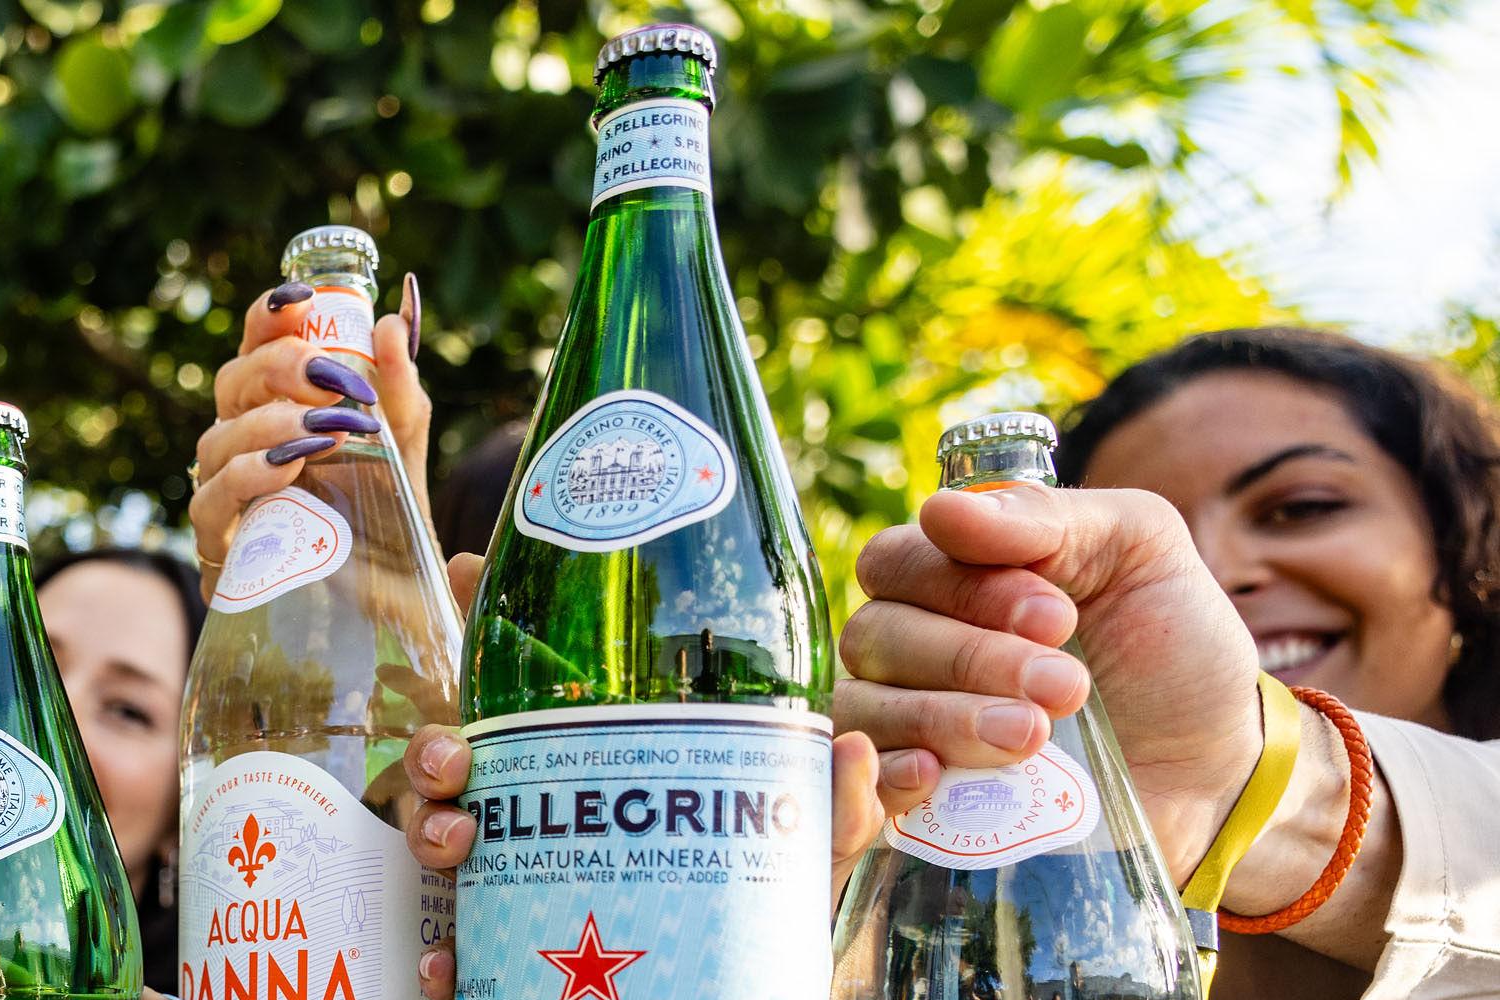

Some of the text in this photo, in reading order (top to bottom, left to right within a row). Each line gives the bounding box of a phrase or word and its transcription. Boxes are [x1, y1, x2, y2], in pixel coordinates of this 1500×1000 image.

[557, 417, 679, 514] SAN PELLEGRINO TERME ITALIA
[583, 503, 639, 520] 1899
[490, 748, 734, 776] SOURCE, SAN PELLEGRINO TERME
[216, 777, 239, 796] YOUR
[243, 771, 273, 785] TASTE
[277, 773, 340, 818] EXPERIENCE
[950, 832, 1001, 848] 1564
[514, 848, 732, 871] NATURAL MINERAL
[482, 869, 729, 888] NATURAL MINERAL WATER WITH ADDED
[207, 898, 309, 949] ACQUA
